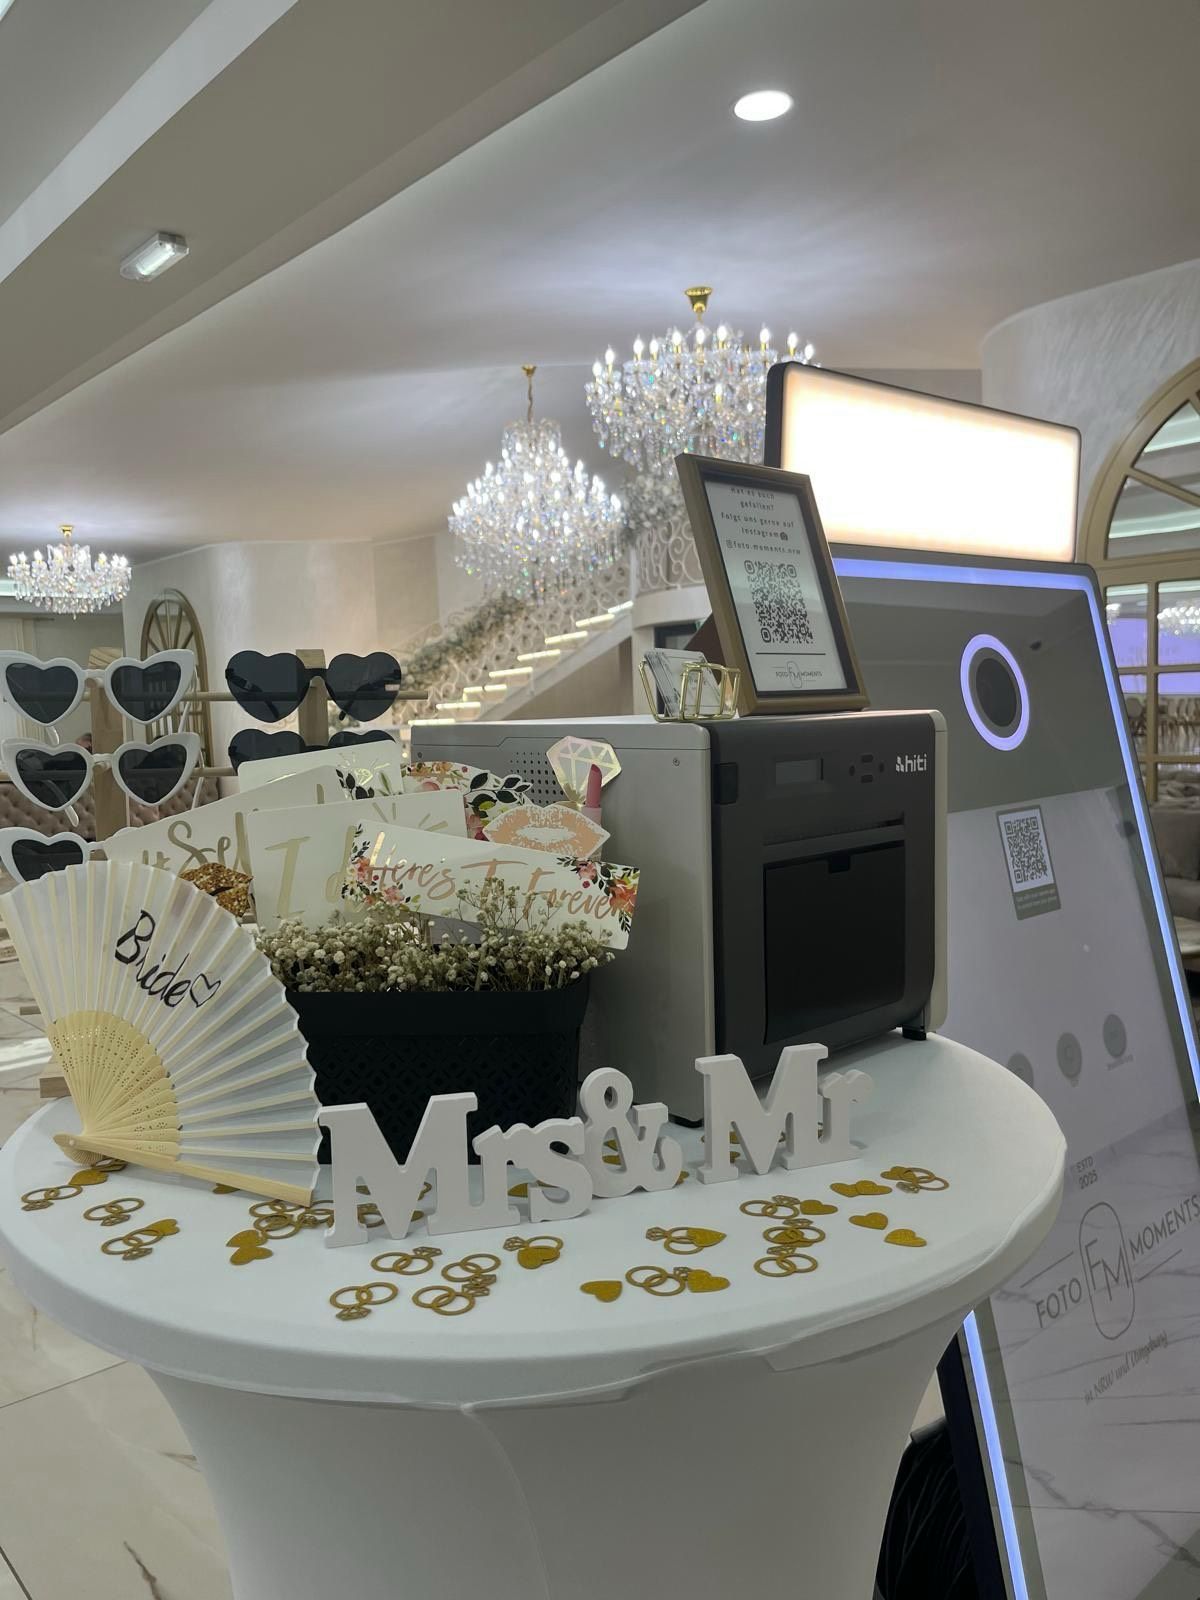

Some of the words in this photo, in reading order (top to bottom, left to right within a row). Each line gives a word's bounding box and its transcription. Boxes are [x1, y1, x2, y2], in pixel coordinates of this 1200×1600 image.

[721, 512, 741, 523] Folgt
[743, 516, 757, 524] uns
[760, 518, 780, 527] gerne
[783, 520, 795, 529] auf
[741, 527, 779, 538] Instagram
[905, 753, 928, 773] hiti
[114, 908, 192, 1008] Bride
[318, 1091, 594, 1249] Mrs
[577, 1066, 684, 1198] &
[694, 1043, 875, 1185] Mr
[1075, 1155, 1094, 1175] ESTD
[1035, 1276, 1083, 1330] FOTO
[1084, 1237, 1129, 1302] FM
[1127, 1194, 1200, 1262] MOMENTS
[1093, 1368, 1114, 1398] NRW
[1114, 1351, 1131, 1381] und
